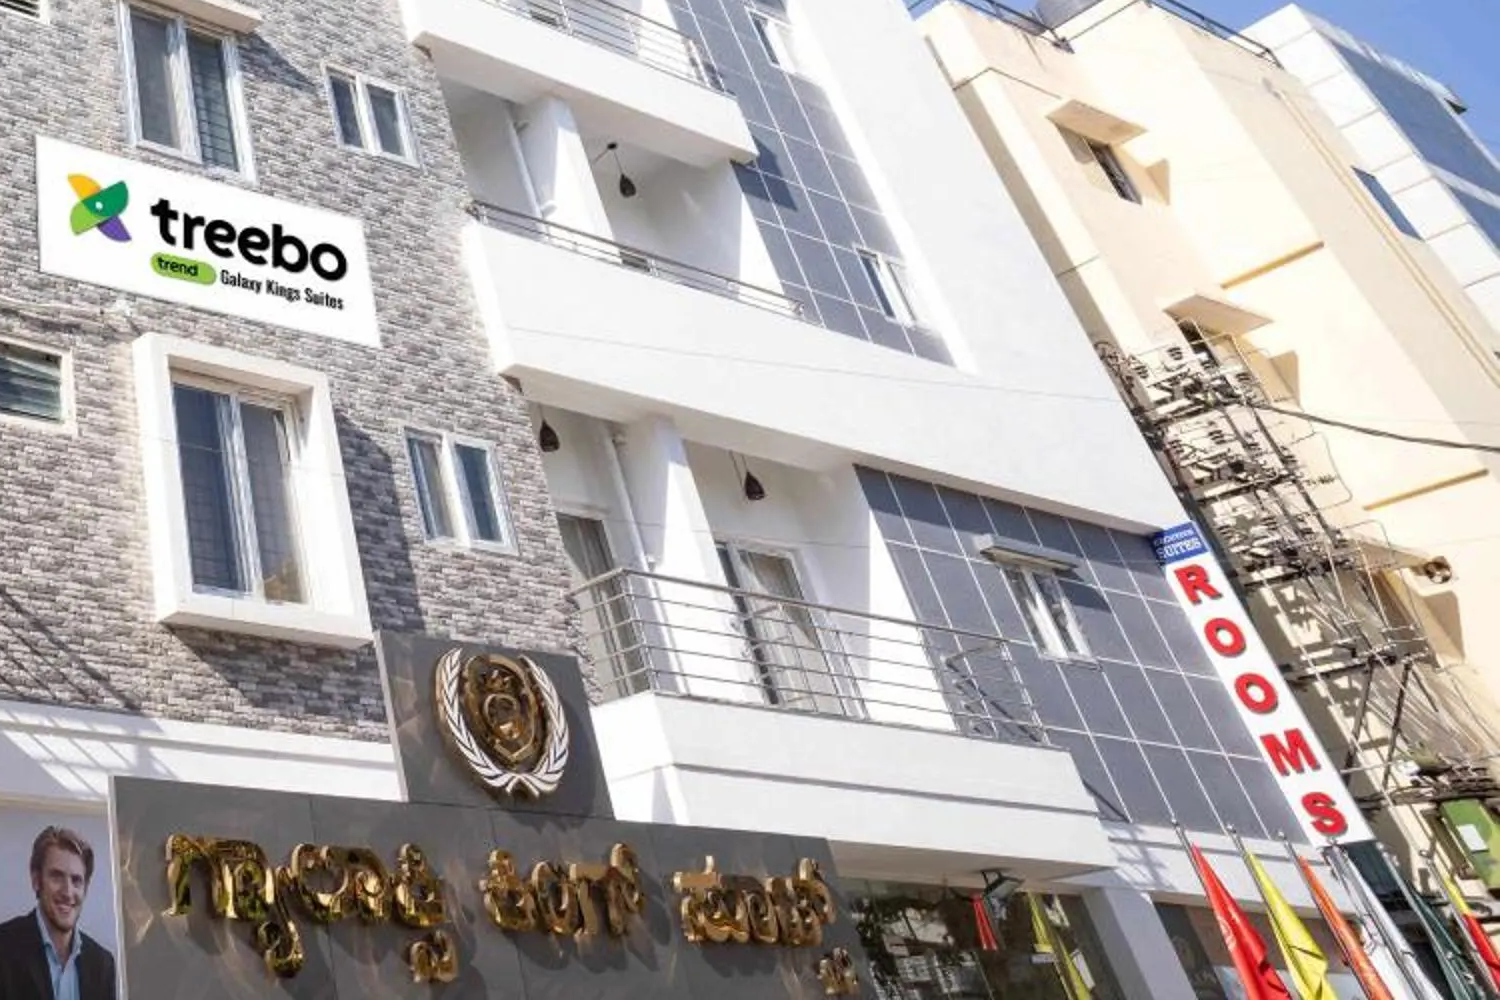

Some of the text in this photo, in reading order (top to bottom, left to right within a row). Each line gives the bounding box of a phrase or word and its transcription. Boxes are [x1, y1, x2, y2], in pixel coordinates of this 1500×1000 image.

[150, 198, 347, 281] treebo
[157, 256, 199, 277] trend
[220, 269, 344, 310] Galaxy Kings Suites
[1173, 563, 1349, 836] ROOMS
